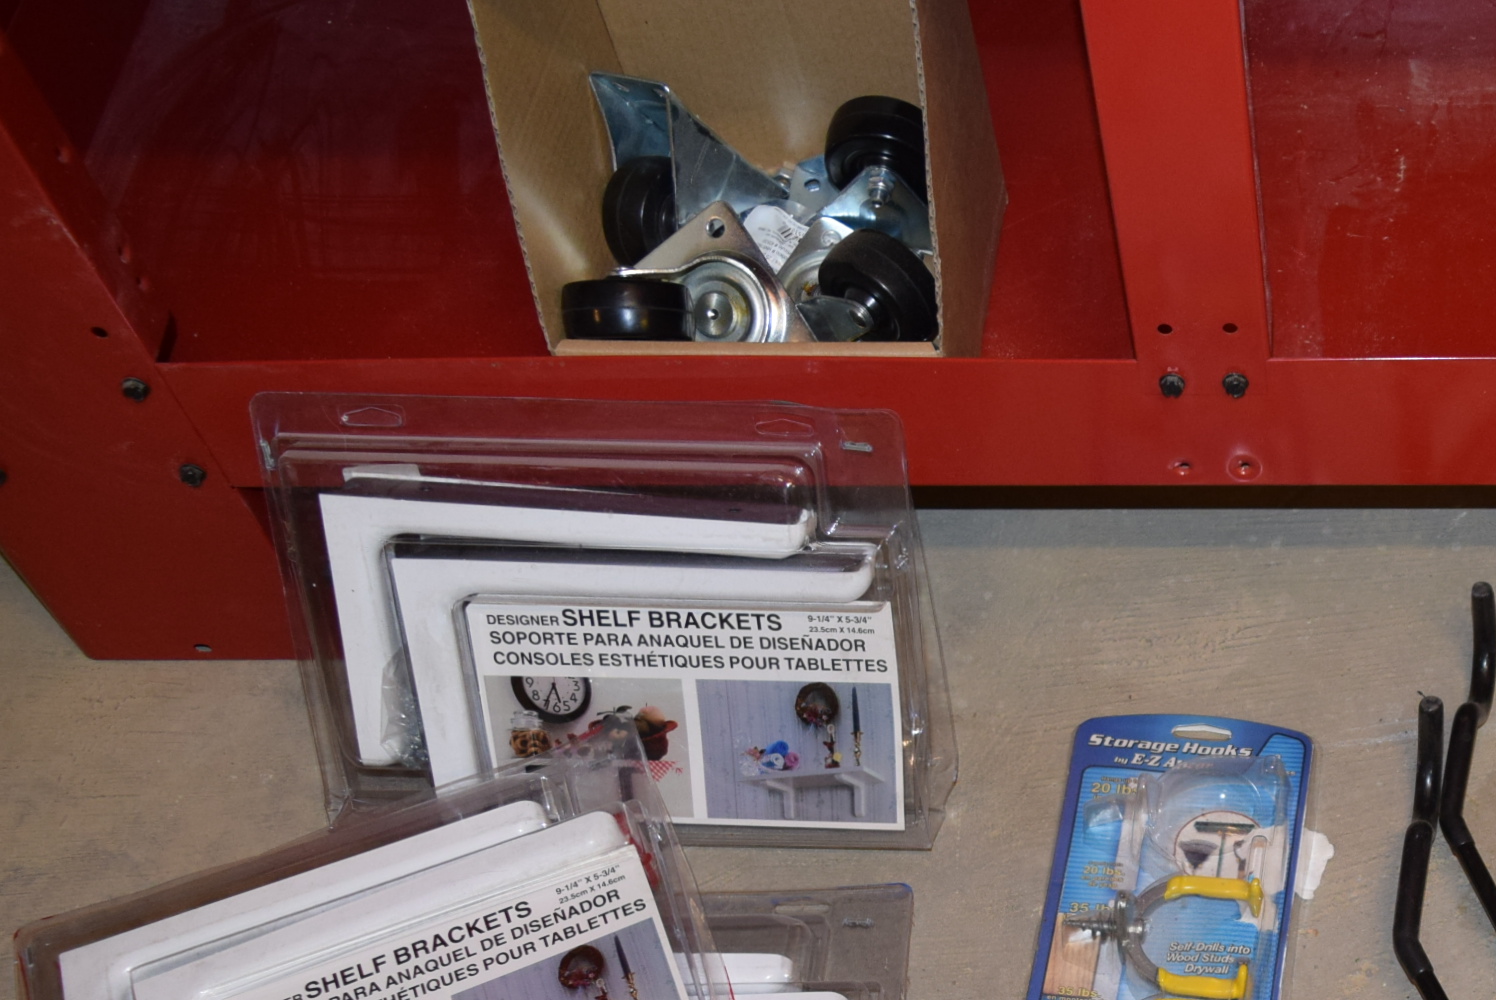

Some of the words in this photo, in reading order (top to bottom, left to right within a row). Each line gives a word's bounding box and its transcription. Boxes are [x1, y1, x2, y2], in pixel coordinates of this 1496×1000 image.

[487, 614, 559, 626] DESIGNER
[562, 609, 641, 628] SHELF
[648, 610, 783, 631] BRACKETS
[489, 631, 578, 646] SOPORTE
[583, 633, 633, 647] PARA
[637, 634, 725, 649] ANAQUEL
[729, 636, 754, 649] DE
[759, 634, 866, 652] DISEÑADOR
[493, 651, 594, 666] CONSOLES
[599, 651, 725, 669] ESTHÉTIQUES
[729, 656, 780, 670] POUR
[784, 657, 888, 673] TABLETTES
[1088, 734, 1179, 754] Storage
[1182, 743, 1254, 757] Hooks
[1114, 756, 1128, 765] by
[1131, 753, 1162, 767] E-Z
[1092, 782, 1111, 794] 20
[1083, 866, 1098, 874] 20
[1069, 902, 1089, 913] 35
[385, 945, 477, 989] ANAQUEL
[480, 933, 507, 952] DE
[510, 888, 621, 940] DISEÑADOR
[483, 941, 537, 971] POUR
[539, 898, 647, 948] TABLETTES
[304, 954, 387, 1000] SHELF
[393, 901, 532, 966] BRACKETS
[1169, 942, 1225, 953] Self-Drills
[1227, 944, 1251, 954] into
[1166, 952, 1199, 963] Wood
[1201, 953, 1235, 964] Studs
[1184, 963, 1230, 975] Drywall
[1058, 986, 1073, 995] 35
